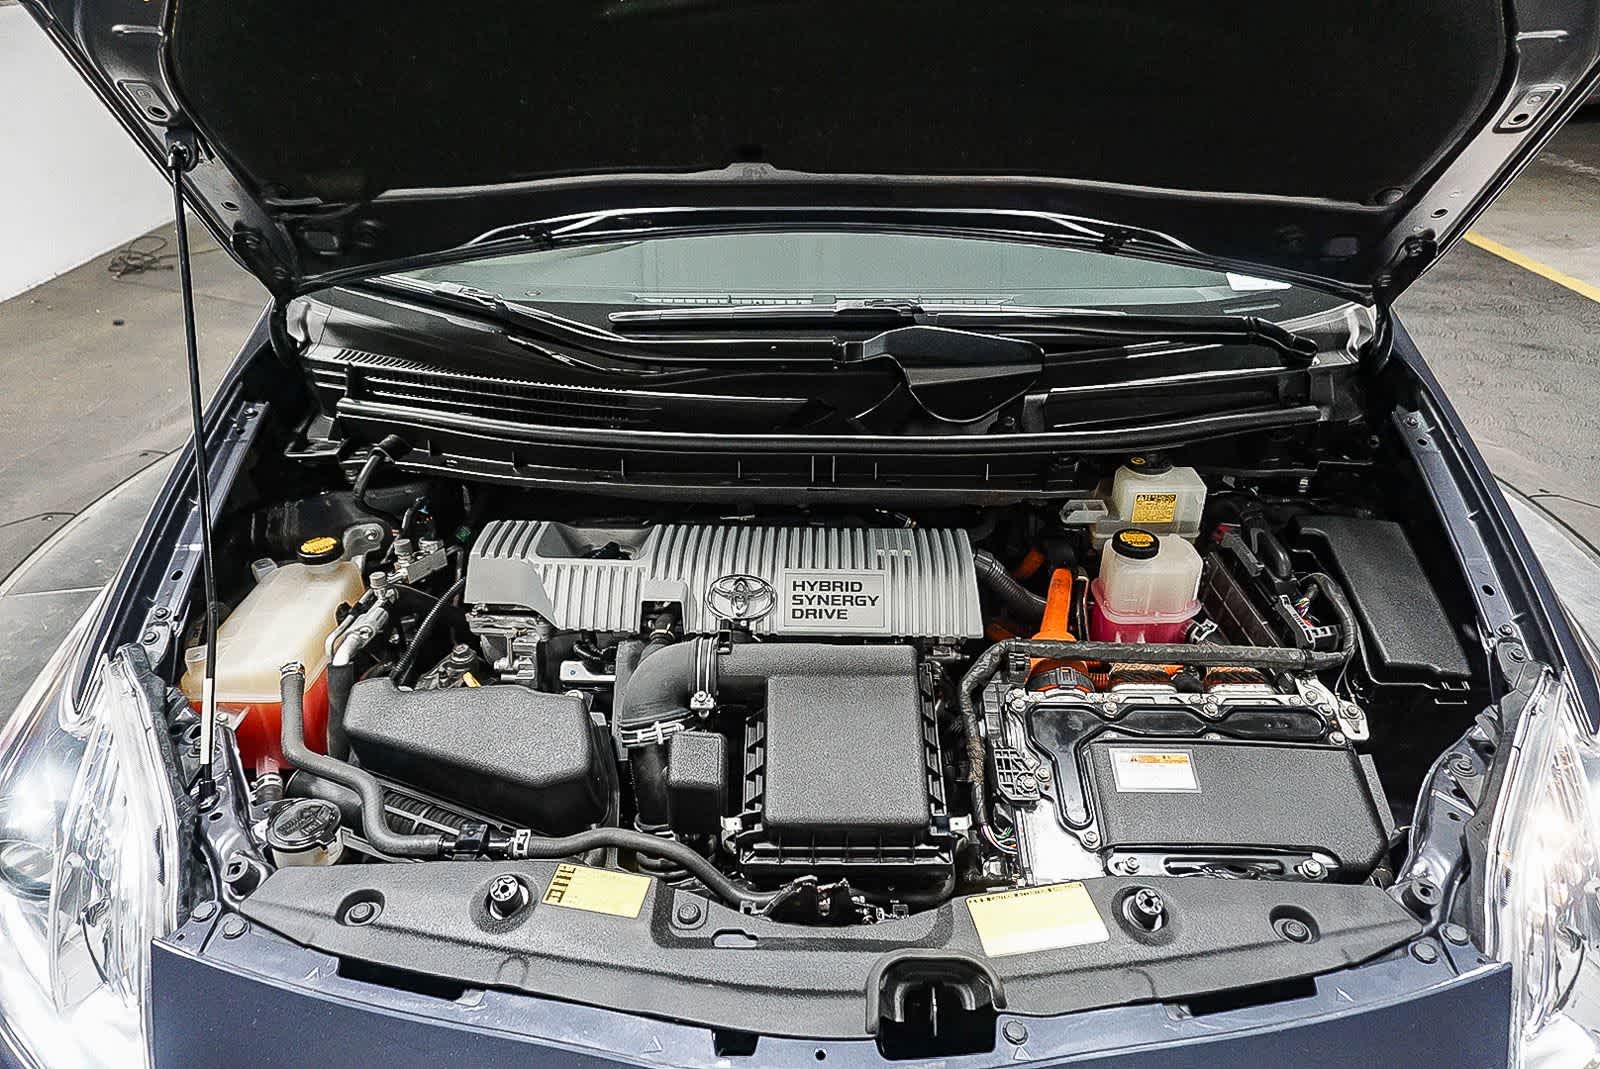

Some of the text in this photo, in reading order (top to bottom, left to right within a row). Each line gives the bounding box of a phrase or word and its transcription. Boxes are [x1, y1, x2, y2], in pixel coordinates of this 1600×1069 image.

[792, 580, 863, 593] HYBRID
[791, 594, 880, 607] SYNERGY
[791, 608, 849, 620] DRIVE
